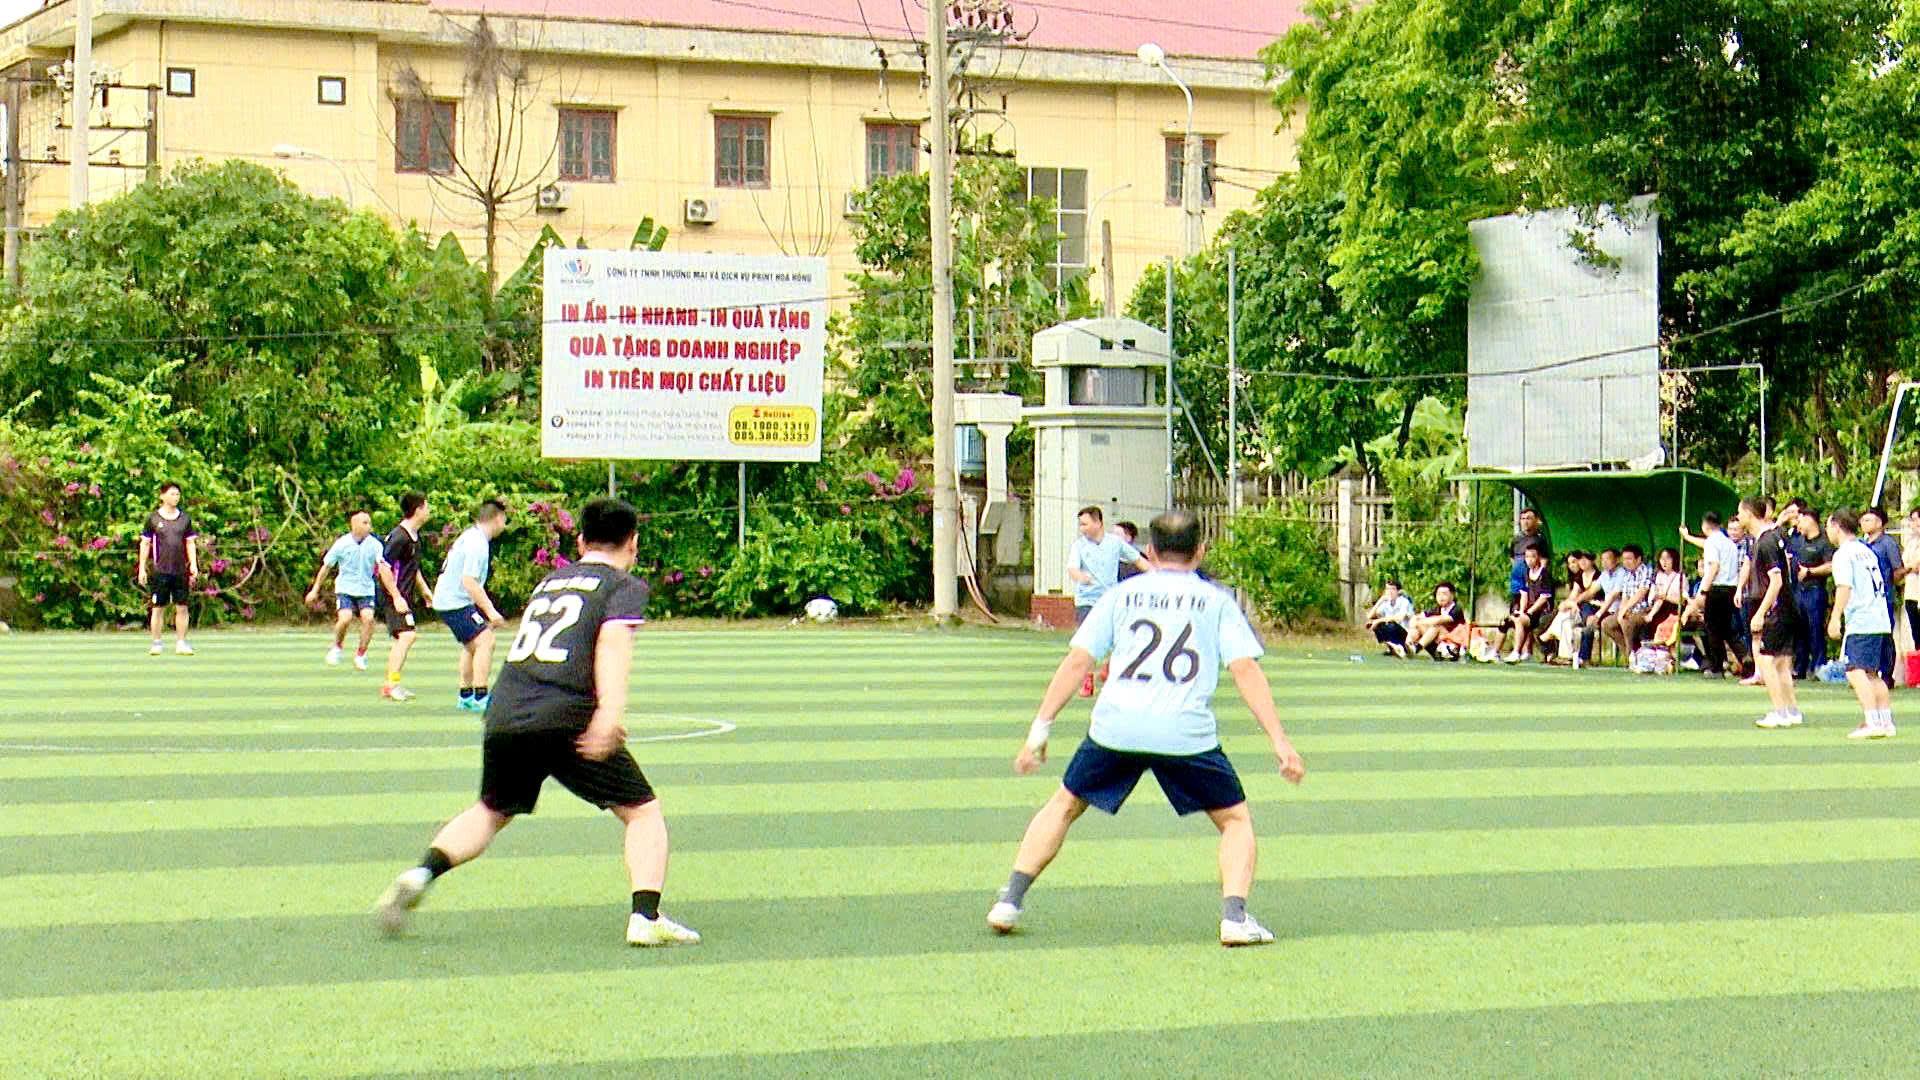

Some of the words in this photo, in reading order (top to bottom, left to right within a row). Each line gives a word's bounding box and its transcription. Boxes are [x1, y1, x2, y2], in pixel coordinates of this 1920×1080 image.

[561, 303, 579, 322] IN
[584, 298, 607, 323] ẤN
[619, 305, 637, 325] IN
[642, 305, 698, 326] NHANH
[710, 308, 727, 327] IN
[732, 305, 764, 330] QUÀ
[769, 303, 810, 332] TẶNG
[569, 333, 607, 358] QUÀ
[612, 334, 661, 360] TẶNG
[667, 338, 729, 360] DOANH
[734, 338, 802, 364] NGHIỆP
[584, 369, 604, 389] IN
[609, 367, 654, 390] TRÊN
[660, 371, 694, 394] MỌI
[699, 367, 744, 392] CHẤT
[748, 370, 786, 397] LIỆU
[507, 594, 584, 663] 62
[1119, 619, 1199, 684] 26
